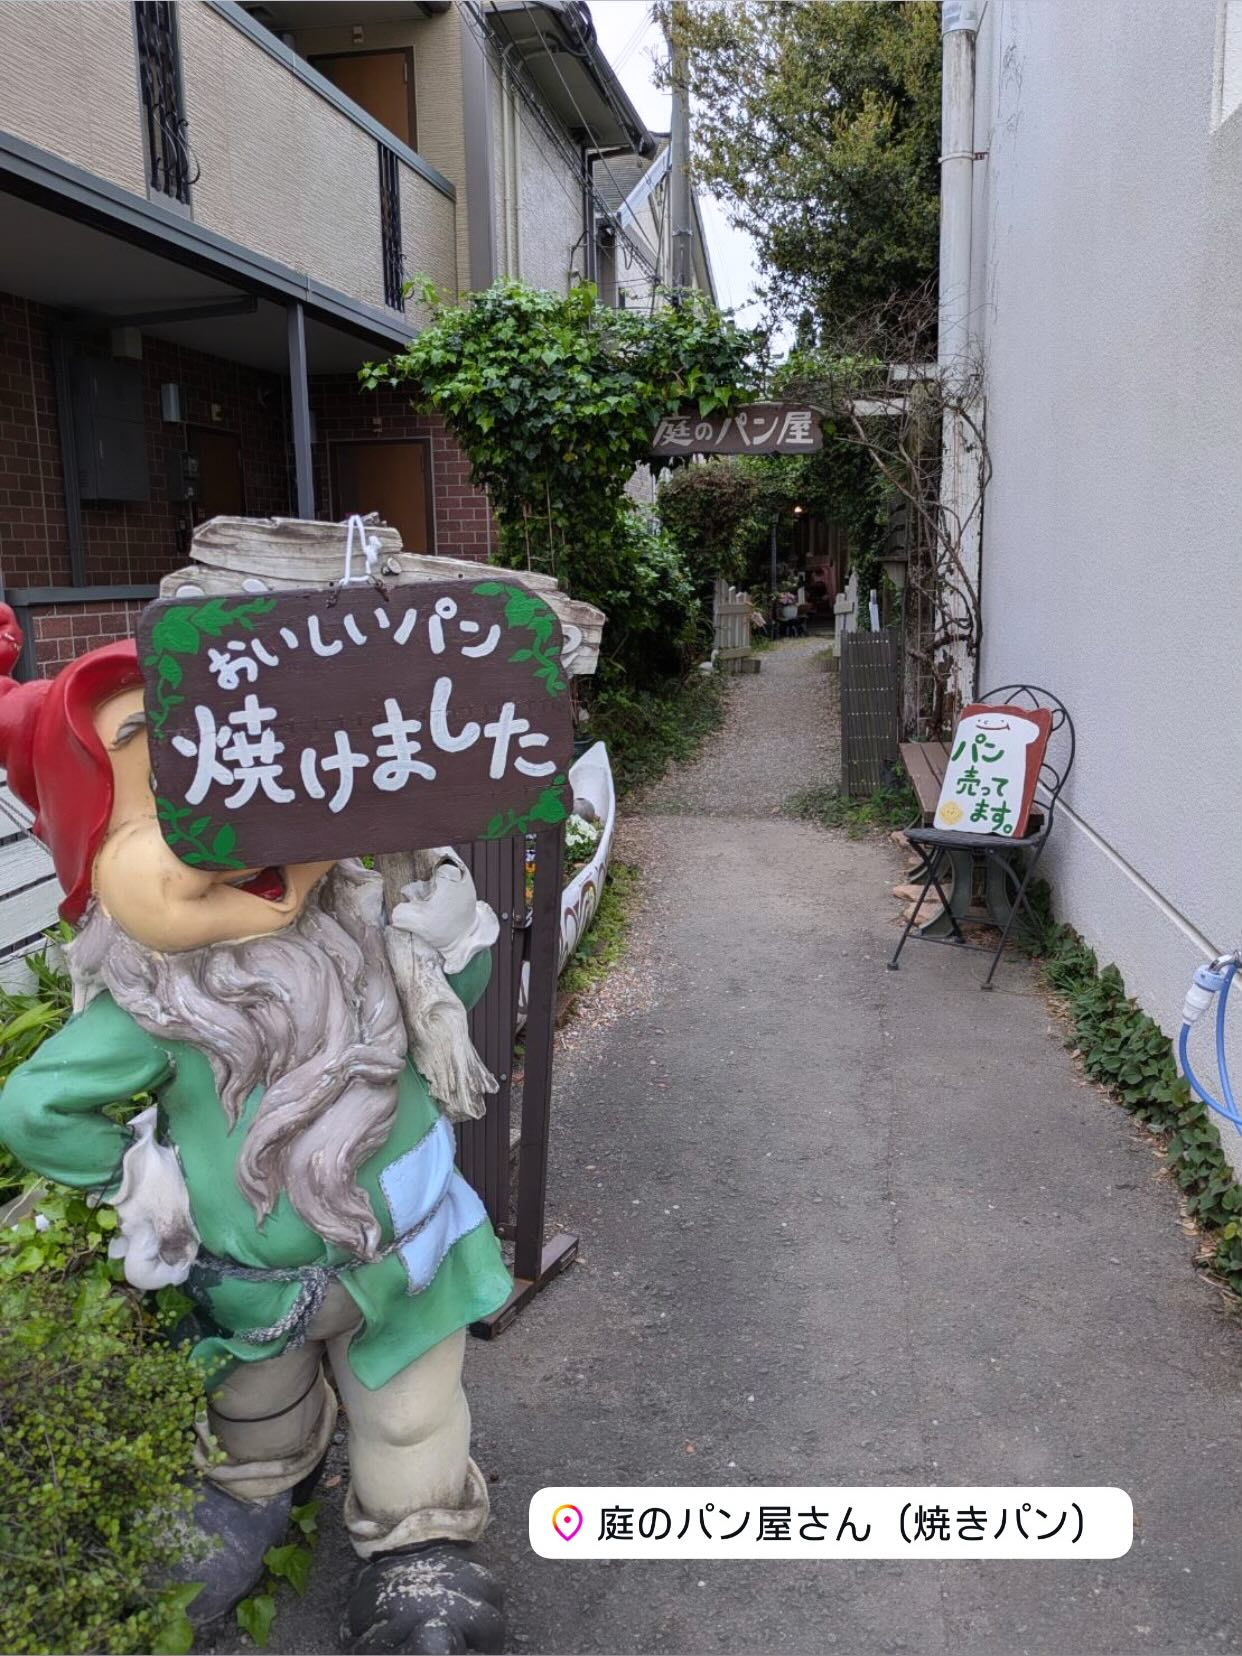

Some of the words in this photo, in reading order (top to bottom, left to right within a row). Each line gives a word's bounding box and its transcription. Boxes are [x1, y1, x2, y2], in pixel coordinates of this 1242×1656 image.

[653, 411, 814, 449] 庭のパン屋
[208, 597, 501, 690] おいしいパン
[172, 676, 557, 813] 焼けました
[952, 733, 1005, 763] パン
[956, 766, 1009, 796] 売って
[970, 799, 1014, 833] ます。
